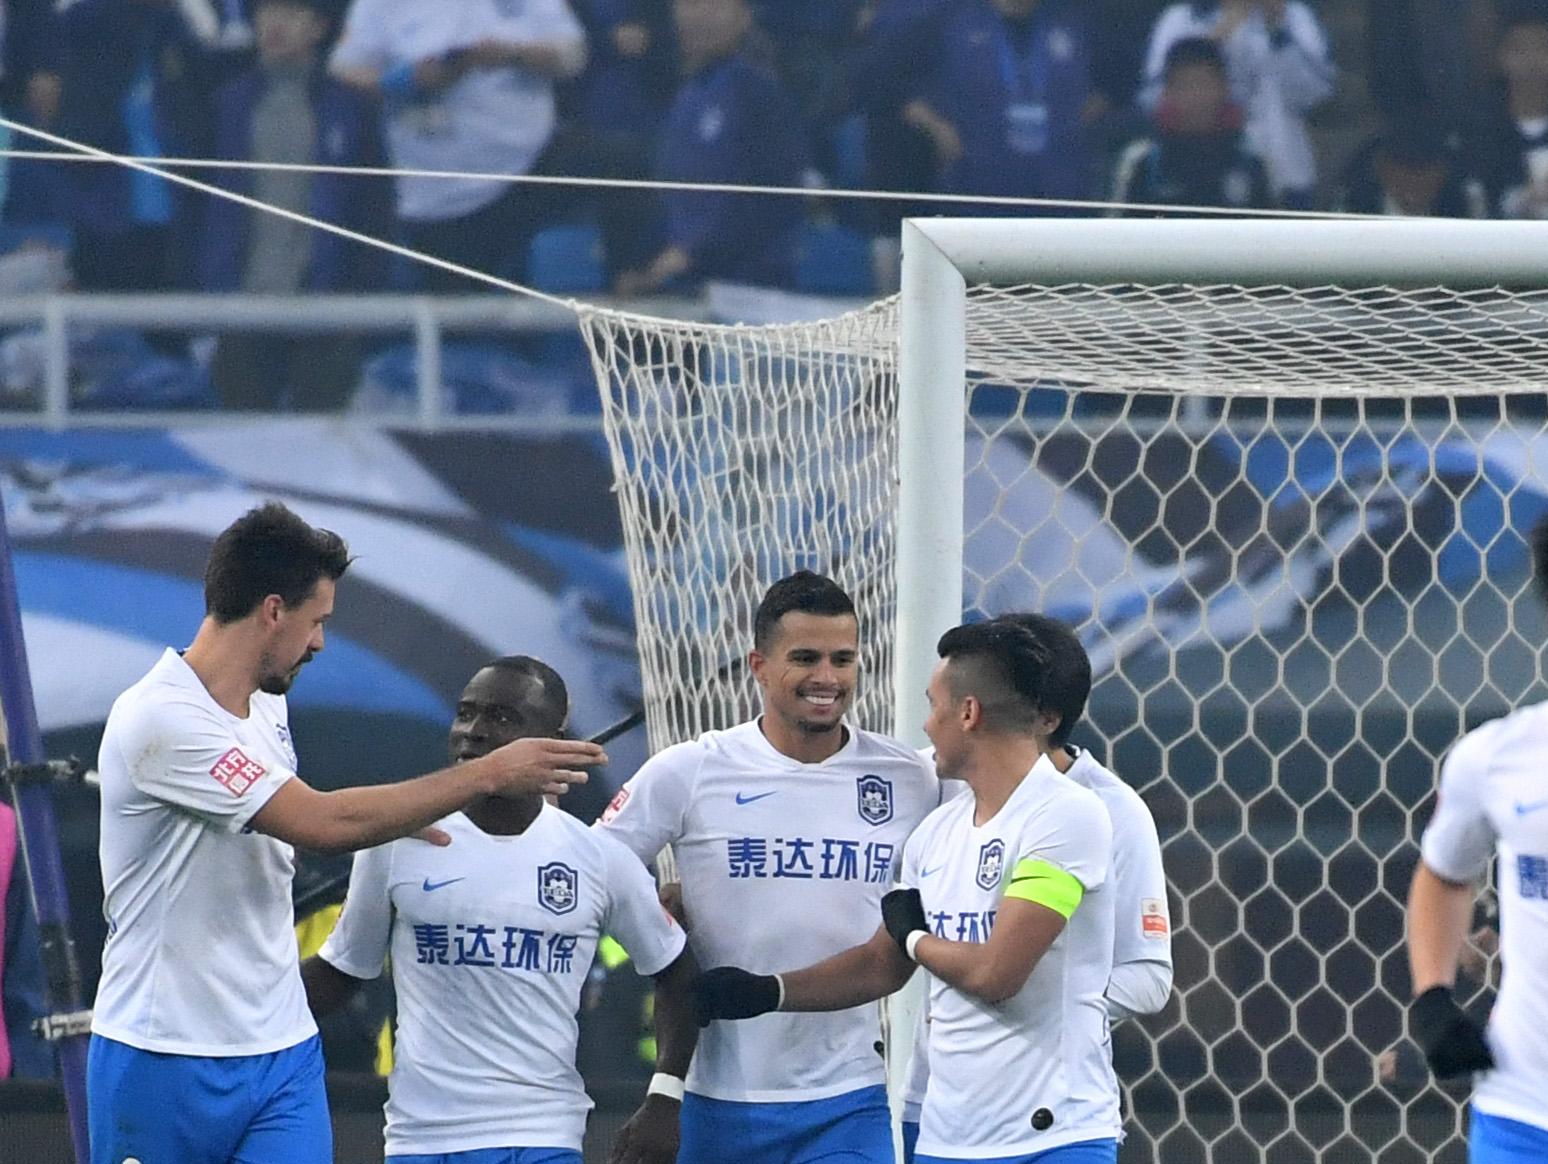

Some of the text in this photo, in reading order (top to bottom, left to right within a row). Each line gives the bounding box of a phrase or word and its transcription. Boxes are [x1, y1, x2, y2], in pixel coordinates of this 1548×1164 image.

[727, 836, 894, 883] 泰达环保
[412, 924, 578, 974] 泰达环保
